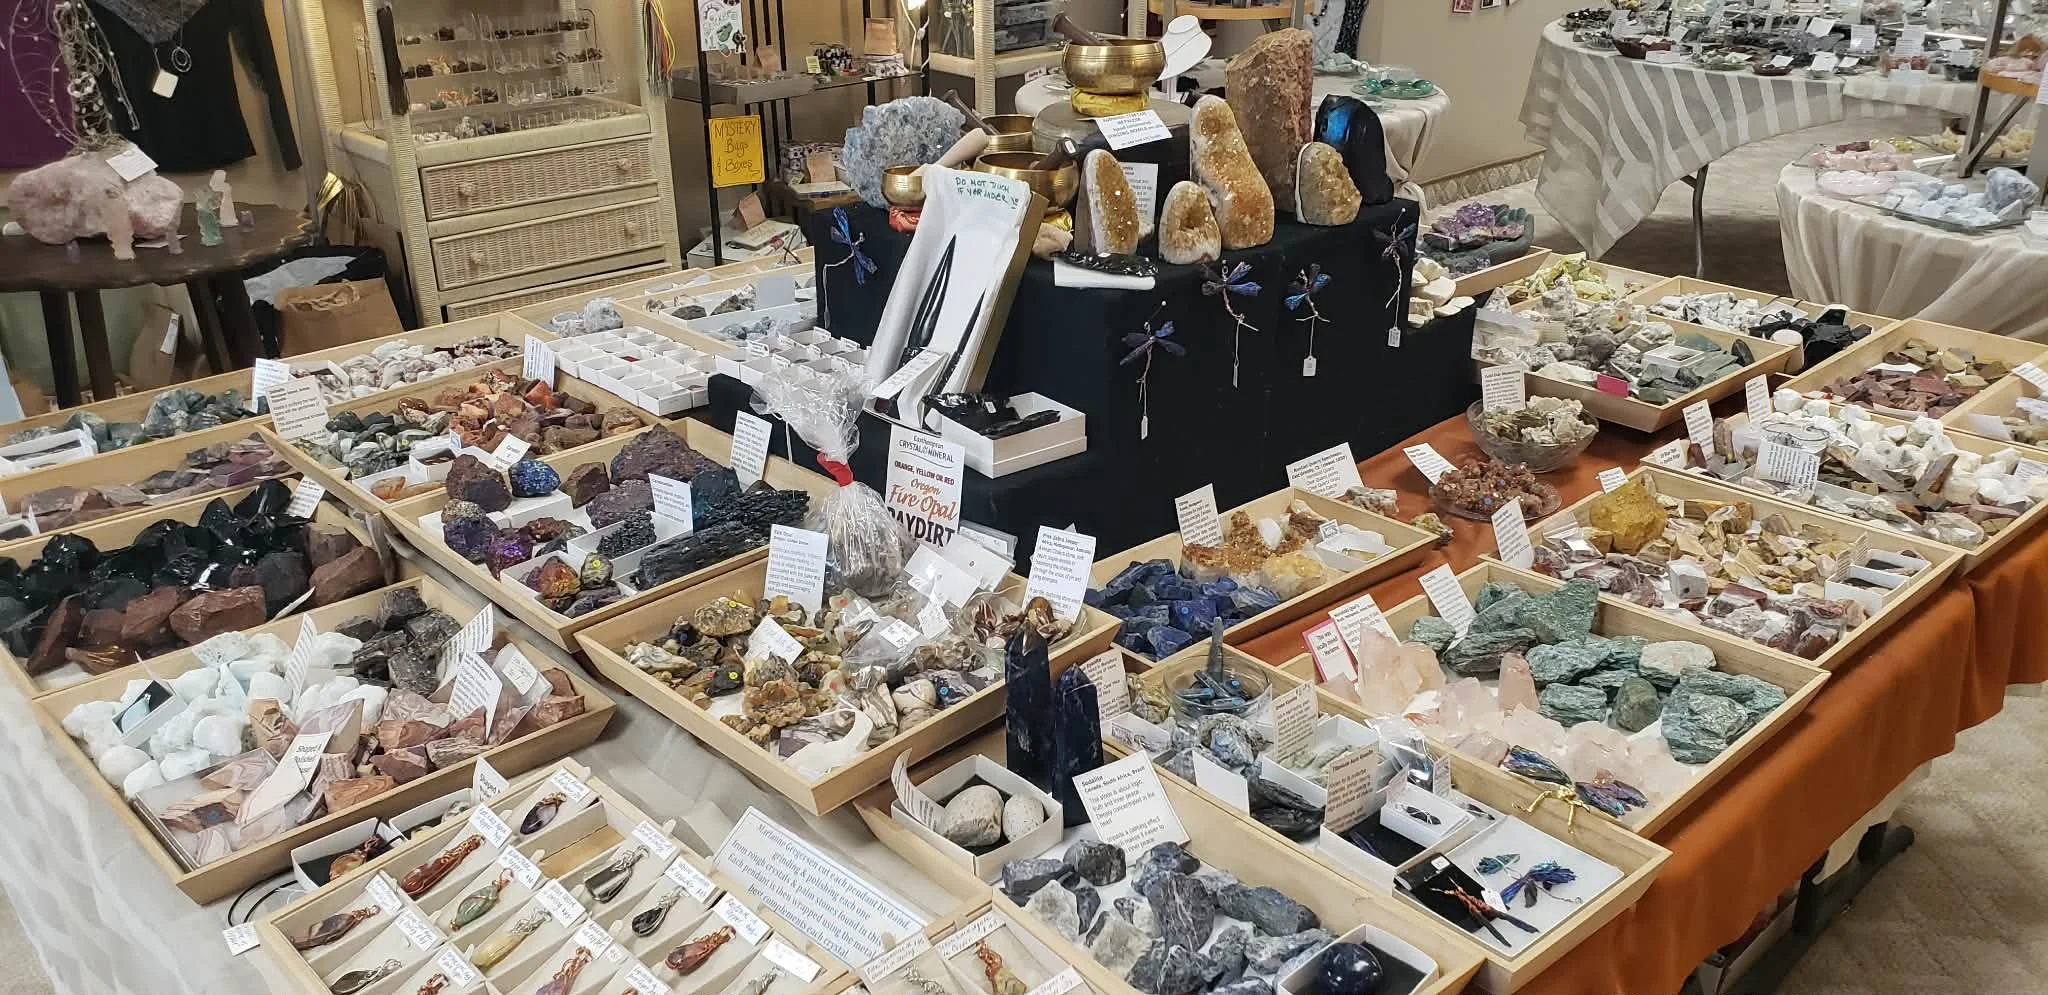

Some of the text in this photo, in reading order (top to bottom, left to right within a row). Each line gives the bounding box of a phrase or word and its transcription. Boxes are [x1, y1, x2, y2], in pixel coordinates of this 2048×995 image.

[714, 119, 757, 139] MYSTERY
[724, 138, 749, 158] Bags
[725, 158, 753, 174] Boxes
[955, 177, 967, 186] DO
[970, 179, 987, 187] NOT
[898, 440, 922, 453] CRYSTAL
[927, 448, 955, 464] MINERAL
[894, 460, 915, 475] ORANGE,
[915, 467, 936, 479] YELLOW
[943, 476, 955, 486] RED
[910, 478, 942, 496] Oregon
[888, 484, 958, 521] Fire Opal
[731, 839, 748, 856] from
[747, 850, 767, 867] rough
[765, 863, 793, 884] crystals
[795, 885, 816, 902] palm
[816, 898, 839, 917] stones
[837, 911, 861, 931] found
[858, 924, 868, 937] in
[866, 931, 882, 947] this
[771, 851, 871, 921] grinding & polishing each one
[785, 841, 819, 869] Gregersen
[818, 863, 831, 877] cut
[829, 872, 848, 890] each
[845, 883, 879, 910] pendant
[877, 902, 889, 916] by
[886, 910, 910, 930] hand.
[727, 852, 744, 870] Each
[741, 865, 770, 887] pendant
[775, 886, 792, 902] then
[791, 898, 824, 923] wrapped
[822, 918, 843, 939] using
[841, 931, 854, 945] the
[853, 940, 877, 960] metal
[762, 894, 807, 930] complements
[806, 926, 824, 942] each
[822, 937, 850, 960] crystal.
